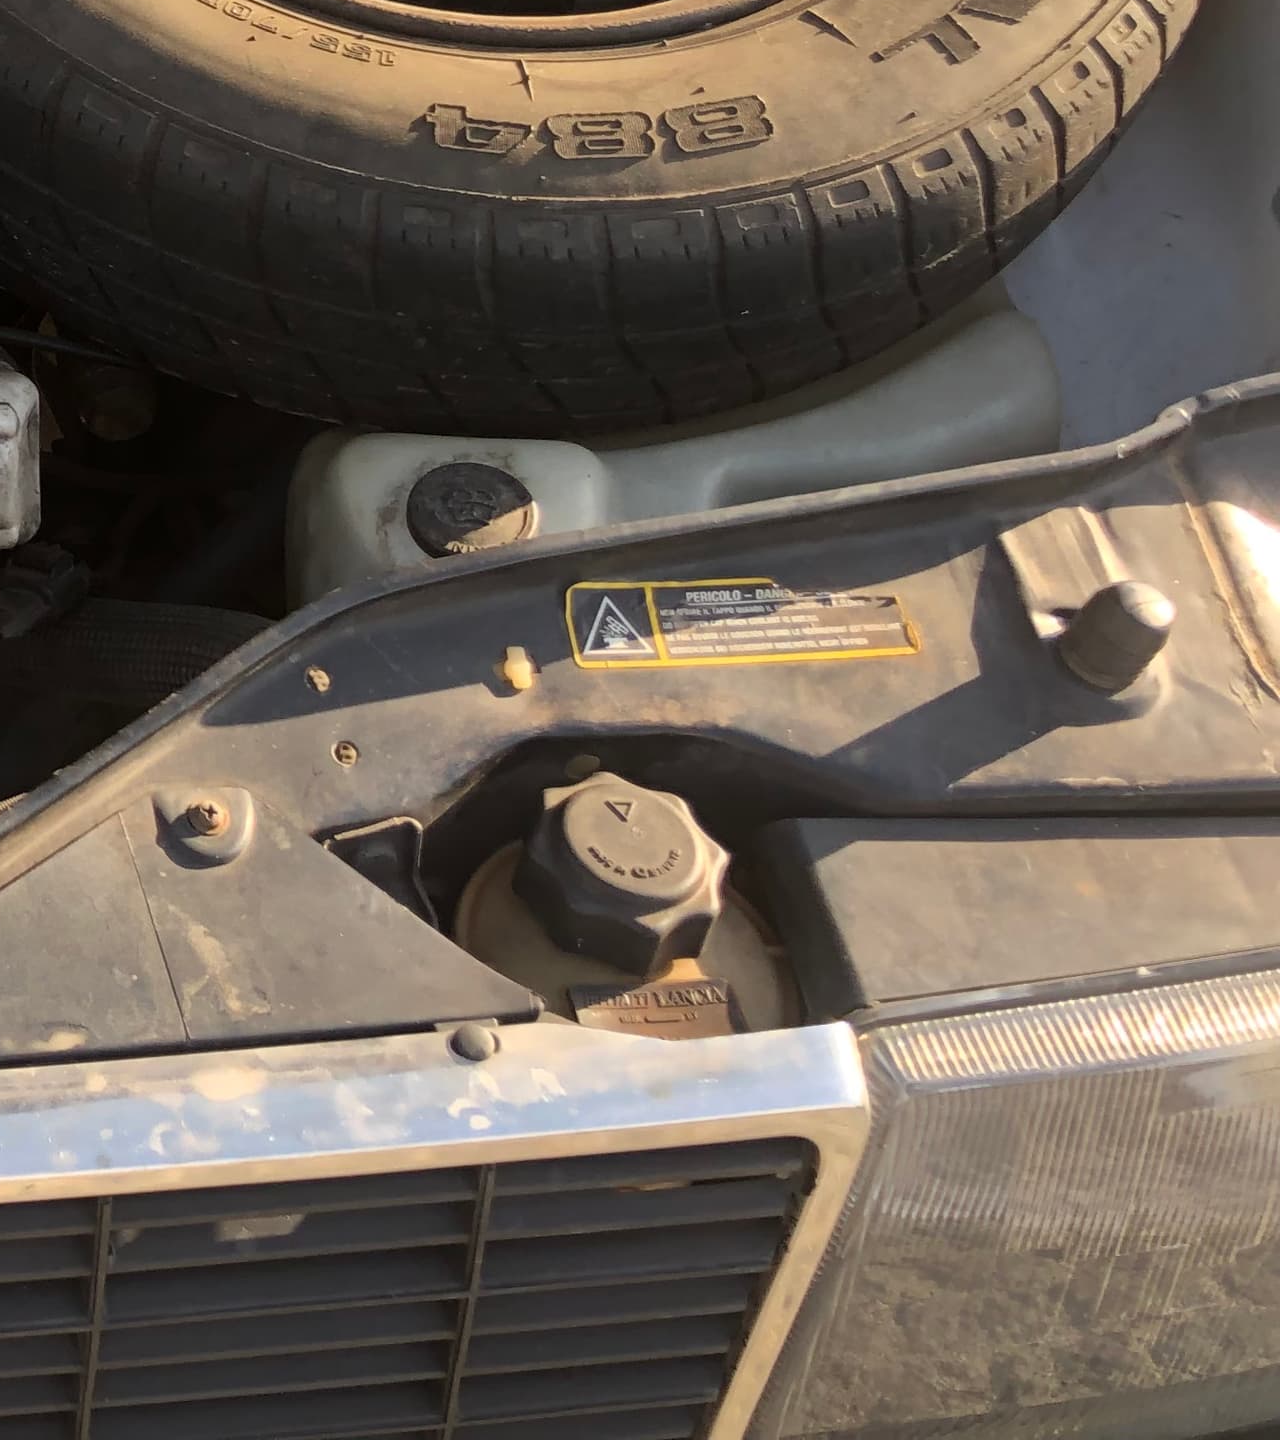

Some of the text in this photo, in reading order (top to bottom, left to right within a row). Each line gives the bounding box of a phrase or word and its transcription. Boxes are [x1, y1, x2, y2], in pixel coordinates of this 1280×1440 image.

[424, 95, 774, 160] 884
[685, 590, 742, 602] PERICOLO
[653, 986, 728, 1007] LANCIA
